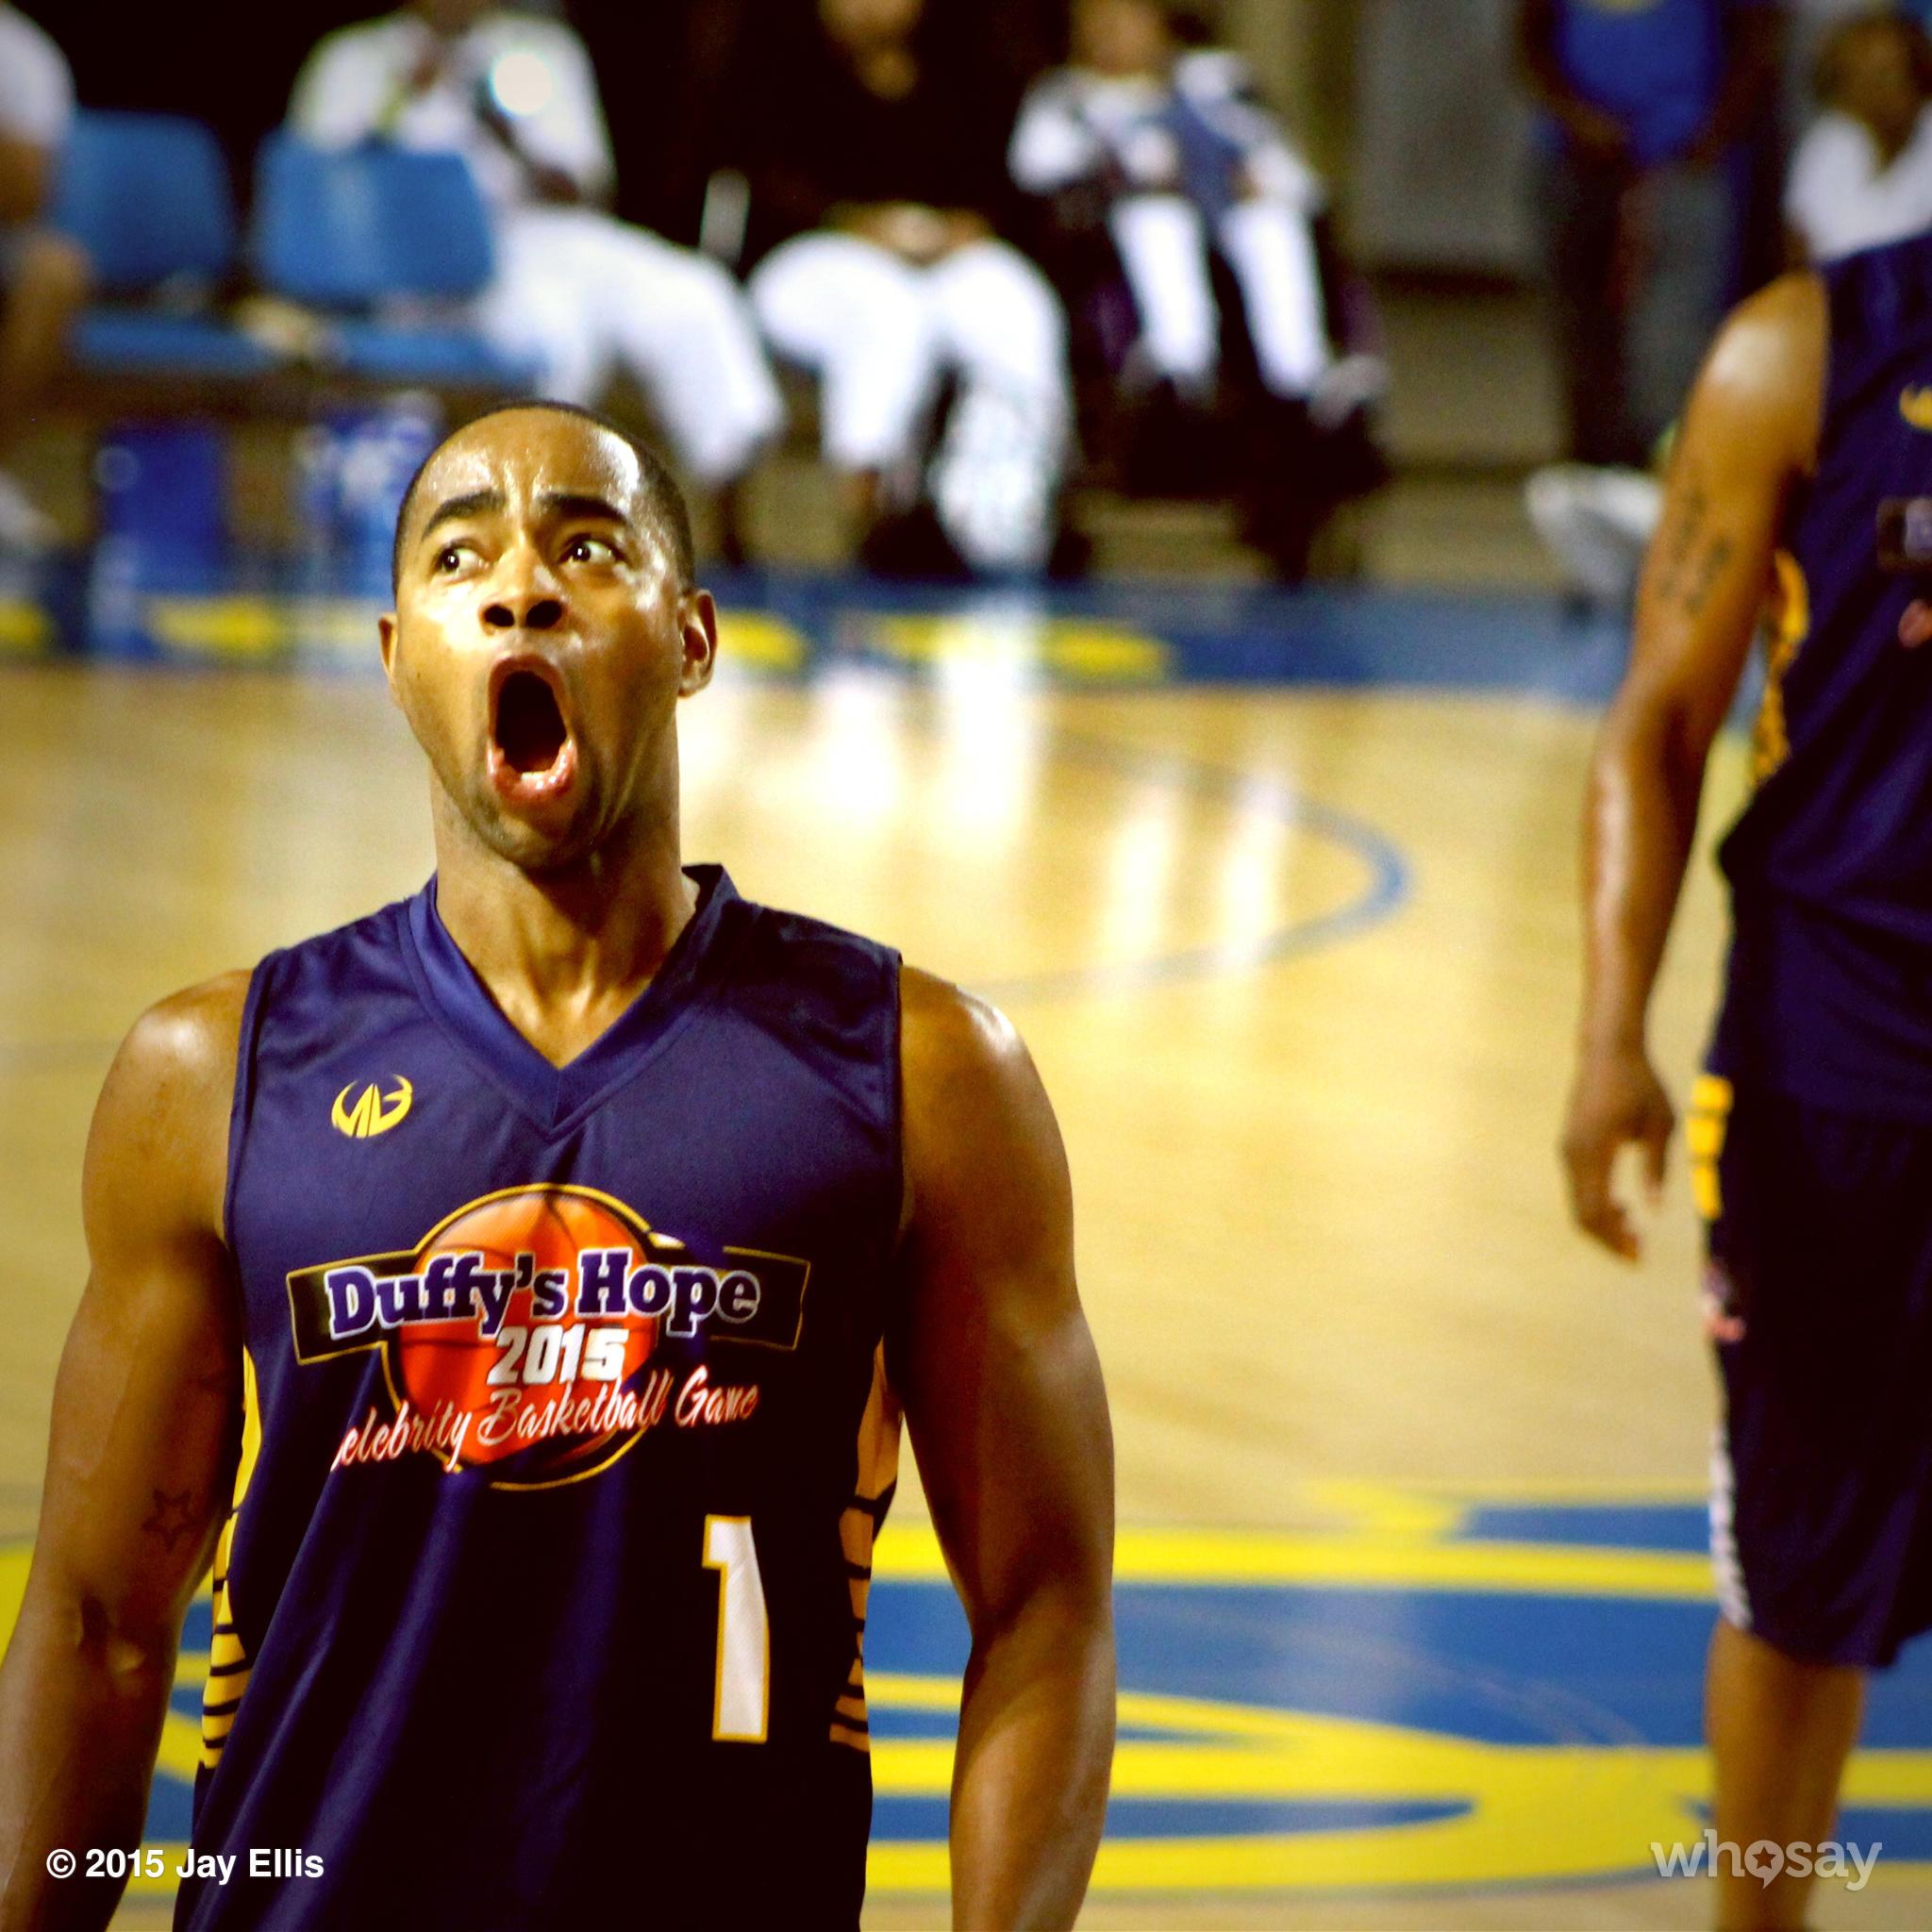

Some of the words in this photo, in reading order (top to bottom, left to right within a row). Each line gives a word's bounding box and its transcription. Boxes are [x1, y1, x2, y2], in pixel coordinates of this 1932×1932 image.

[324, 1250, 570, 1341] Duffy's
[575, 1246, 761, 1338] Hope
[486, 1322, 630, 1387] 2015
[330, 1400, 473, 1473] elebrity
[476, 1369, 671, 1446] Basketball
[674, 1364, 758, 1428] Game
[702, 1514, 771, 1743] 1
